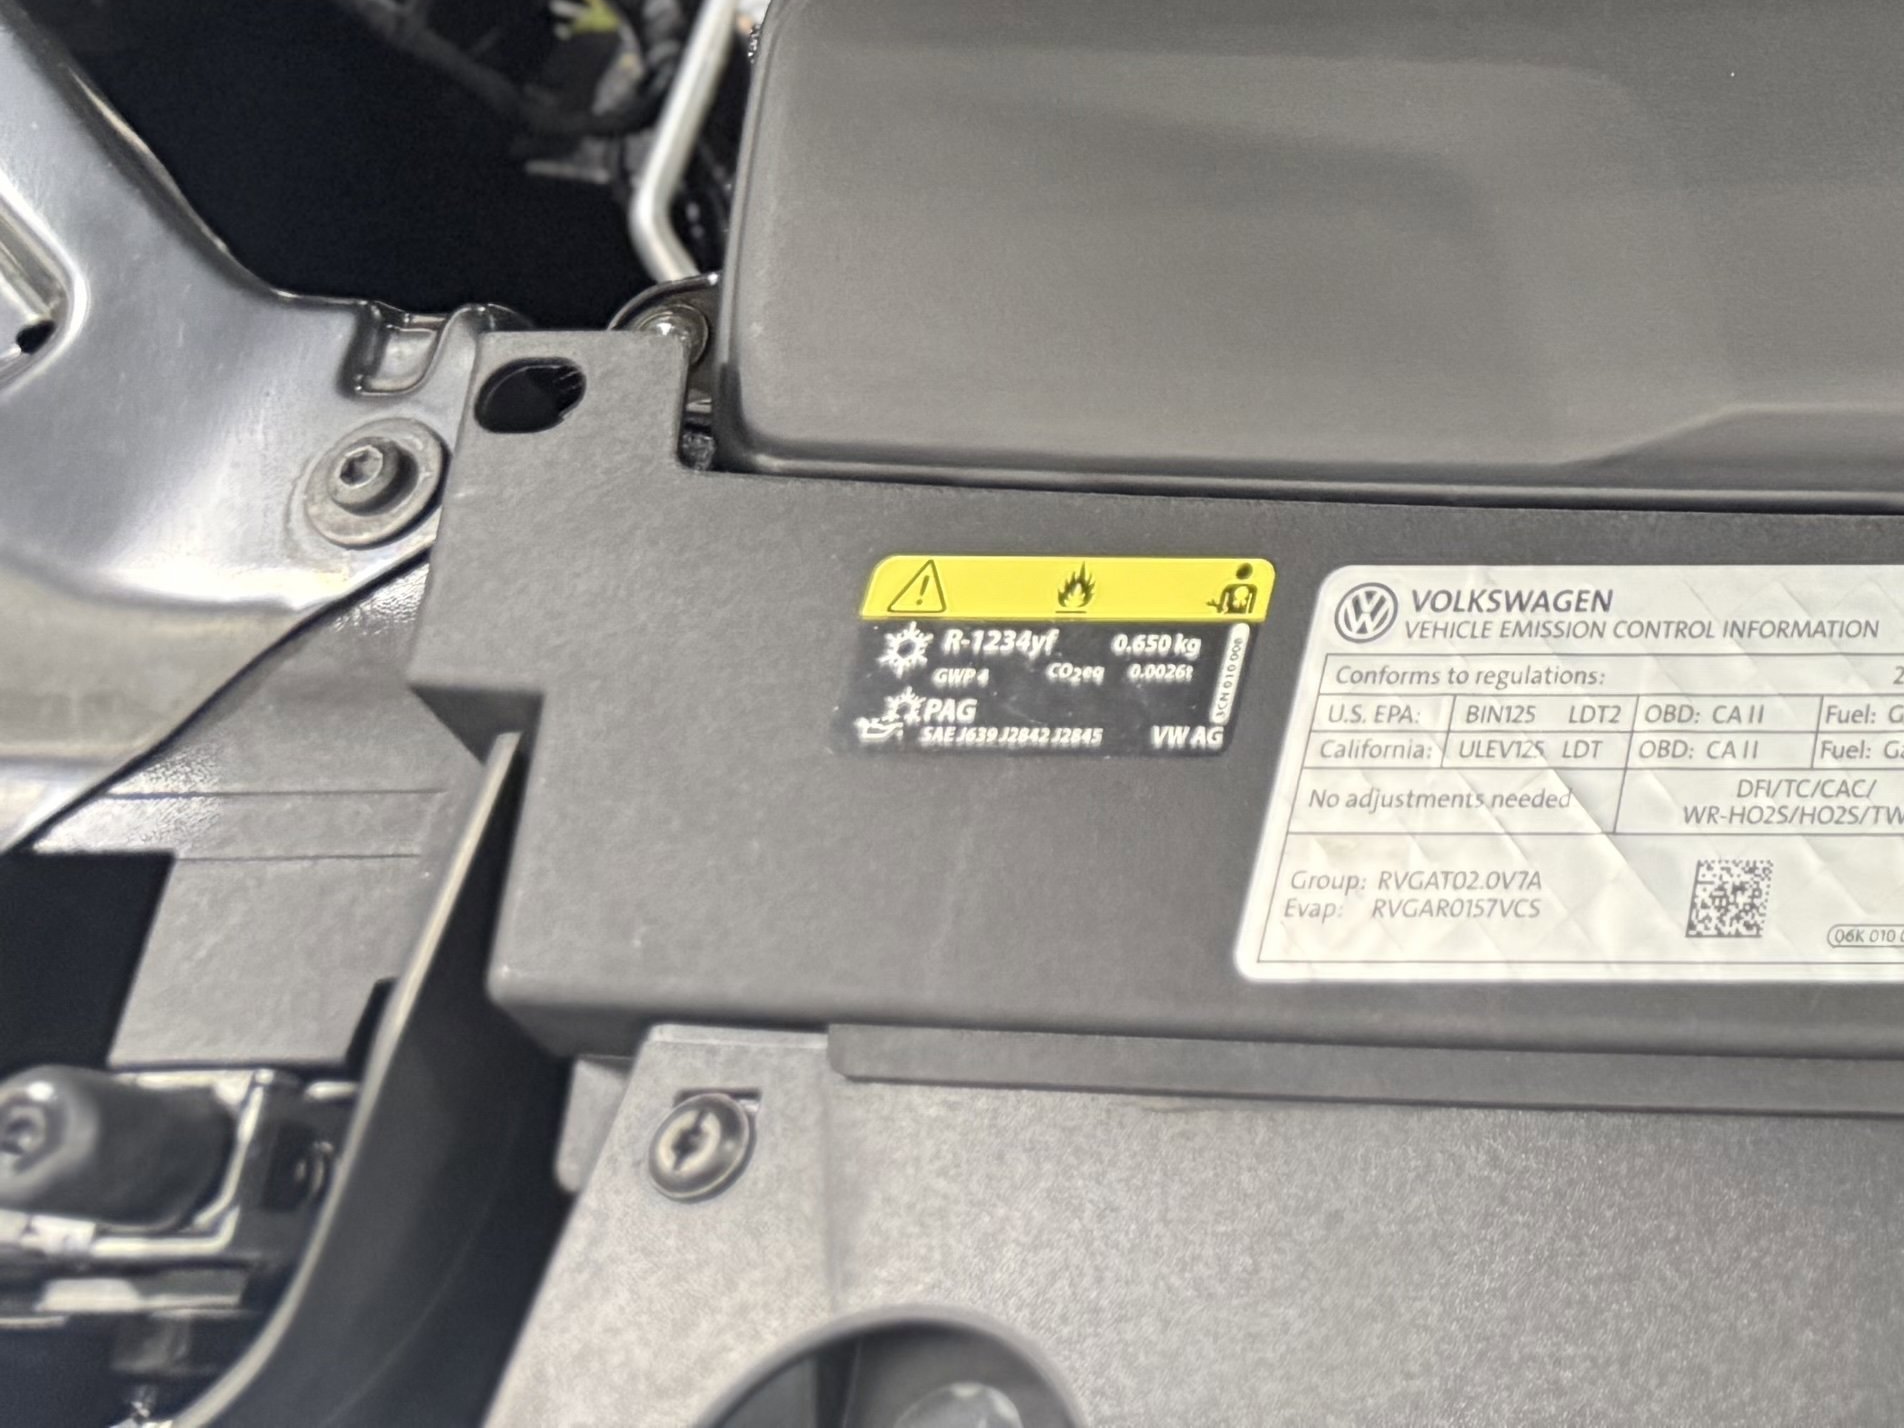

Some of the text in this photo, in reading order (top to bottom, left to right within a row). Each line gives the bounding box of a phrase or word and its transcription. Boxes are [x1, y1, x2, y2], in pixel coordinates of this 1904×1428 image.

[1412, 589, 1613, 613] VOLKSWAGEN
[1405, 619, 1879, 639] VEHICLE EMISSION CONTROL INFORMATION
[942, 628, 1201, 660] R-1234yf 0.650 kg
[1336, 665, 1440, 685] Conforms
[1448, 667, 1469, 685] to
[1475, 665, 1605, 691] regulations:
[923, 698, 978, 724] PAG
[1328, 704, 1366, 724] U.S.
[1373, 704, 1420, 724] EPA:
[1465, 704, 1536, 724] BIN125
[1568, 705, 1621, 724] LDT2
[1644, 704, 1700, 724] OBD:
[1825, 704, 1876, 724] Fuel:
[1151, 725, 1224, 745] VW AG
[1319, 738, 1432, 759] California:
[1459, 739, 1547, 760] ULEV125
[1561, 739, 1603, 759] LDT
[1638, 739, 1694, 759] OBD:
[1820, 740, 1871, 759] Fuel:
[1308, 786, 1573, 814] No adjustments needed
[1736, 779, 1877, 799] DFI/TC/CAC/
[1290, 870, 1366, 896] Group:
[1284, 897, 1342, 924] Evap:
